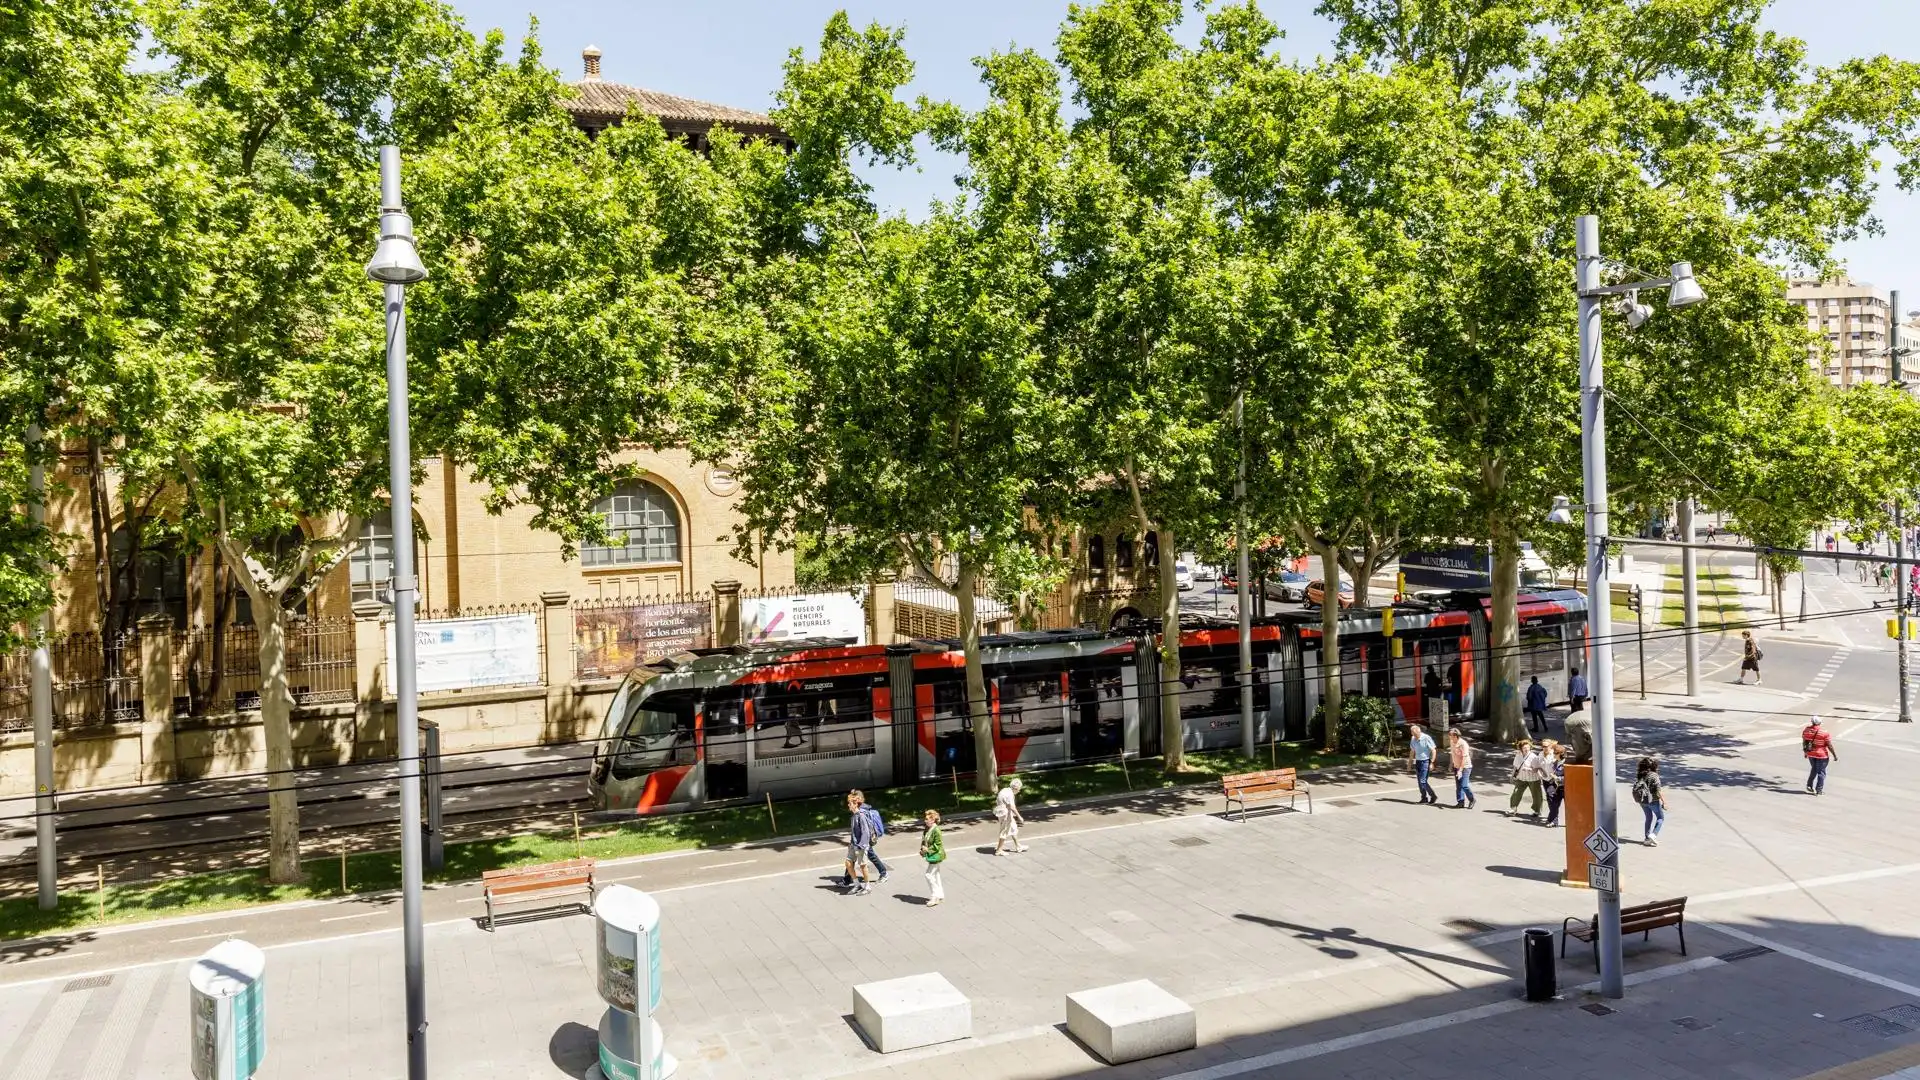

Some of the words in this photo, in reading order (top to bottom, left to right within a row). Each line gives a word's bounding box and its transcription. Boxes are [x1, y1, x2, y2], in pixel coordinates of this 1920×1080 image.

[793, 605, 814, 613] MUSEO
[645, 618, 685, 628] horizonte
[793, 620, 831, 628] NATURALES
[645, 628, 657, 638] de
[657, 627, 670, 637] los
[671, 626, 702, 636] artistas
[646, 638, 693, 649] aragoneses
[1593, 838, 1608, 852] 20
[1594, 867, 1608, 878] LM
